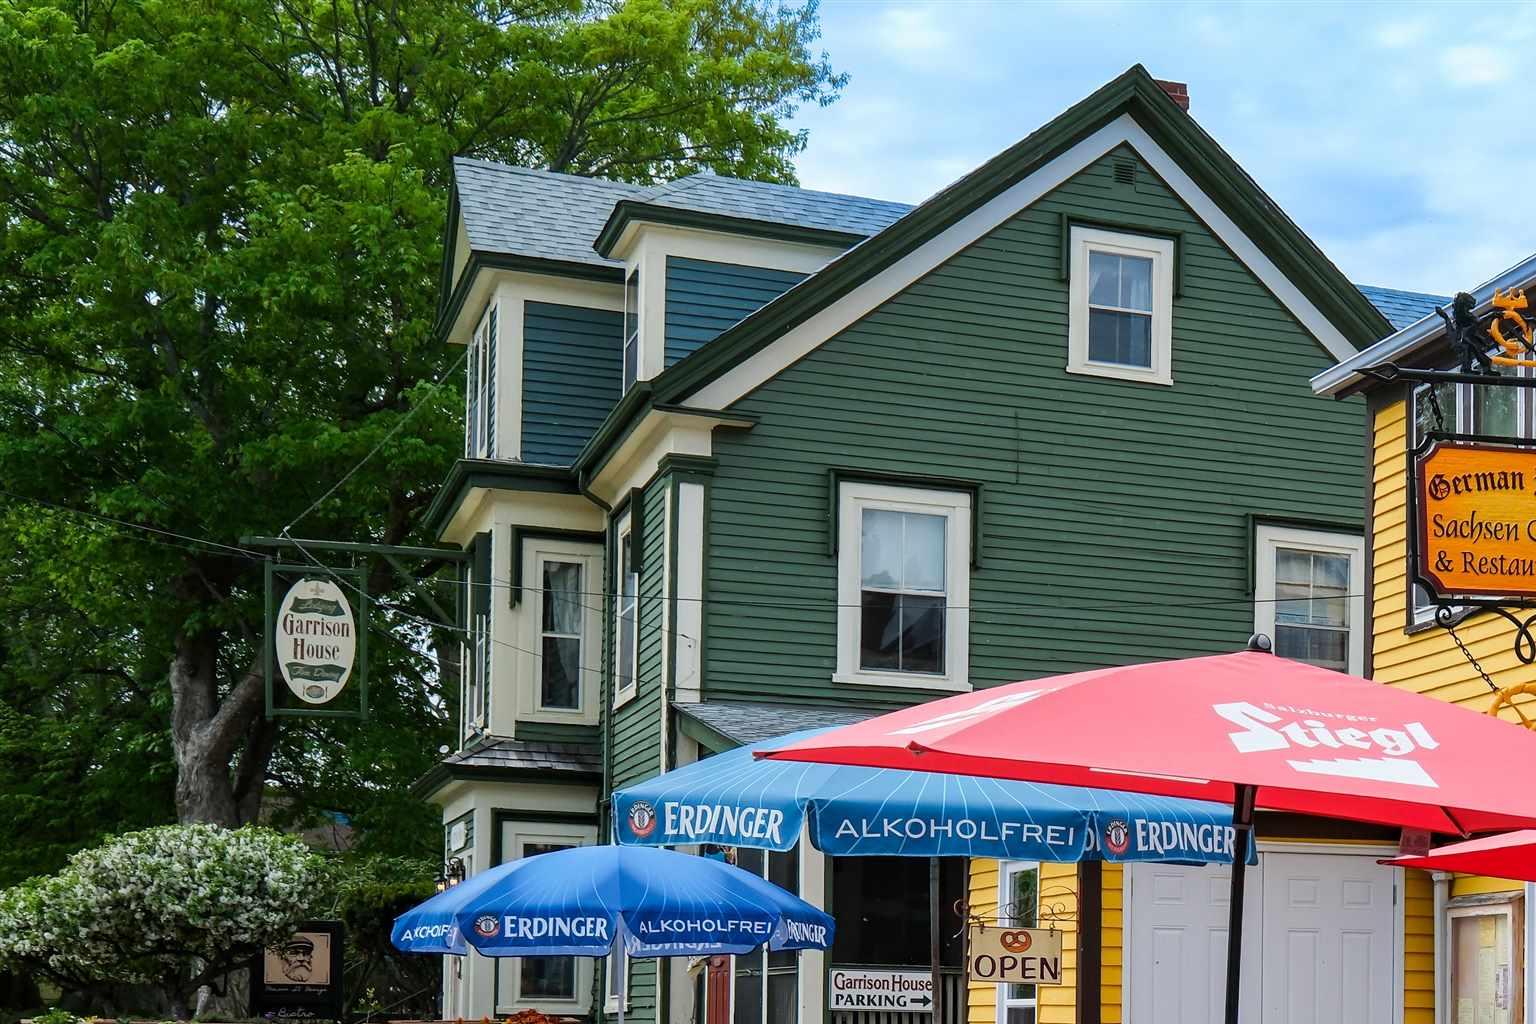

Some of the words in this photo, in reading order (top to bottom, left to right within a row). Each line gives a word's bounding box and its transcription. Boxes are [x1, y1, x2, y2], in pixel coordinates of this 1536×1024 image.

[1428, 470, 1525, 501] German
[1432, 510, 1519, 544] Sachsen
[1435, 550, 1454, 572] &
[282, 614, 350, 637] Garrison
[293, 638, 340, 660] House
[1212, 701, 1440, 756] Stiegl
[664, 801, 784, 844] ERDINGER
[835, 818, 1074, 846] ALKOHOLFREI
[1135, 819, 1235, 855] ERDINGER
[504, 915, 608, 940] ERDINGER
[639, 919, 772, 934] ALKOHOLFREI
[974, 954, 1059, 980] OPEN
[834, 972, 890, 992] Garrison
[891, 974, 933, 992] House
[835, 994, 907, 1007] PARKING
